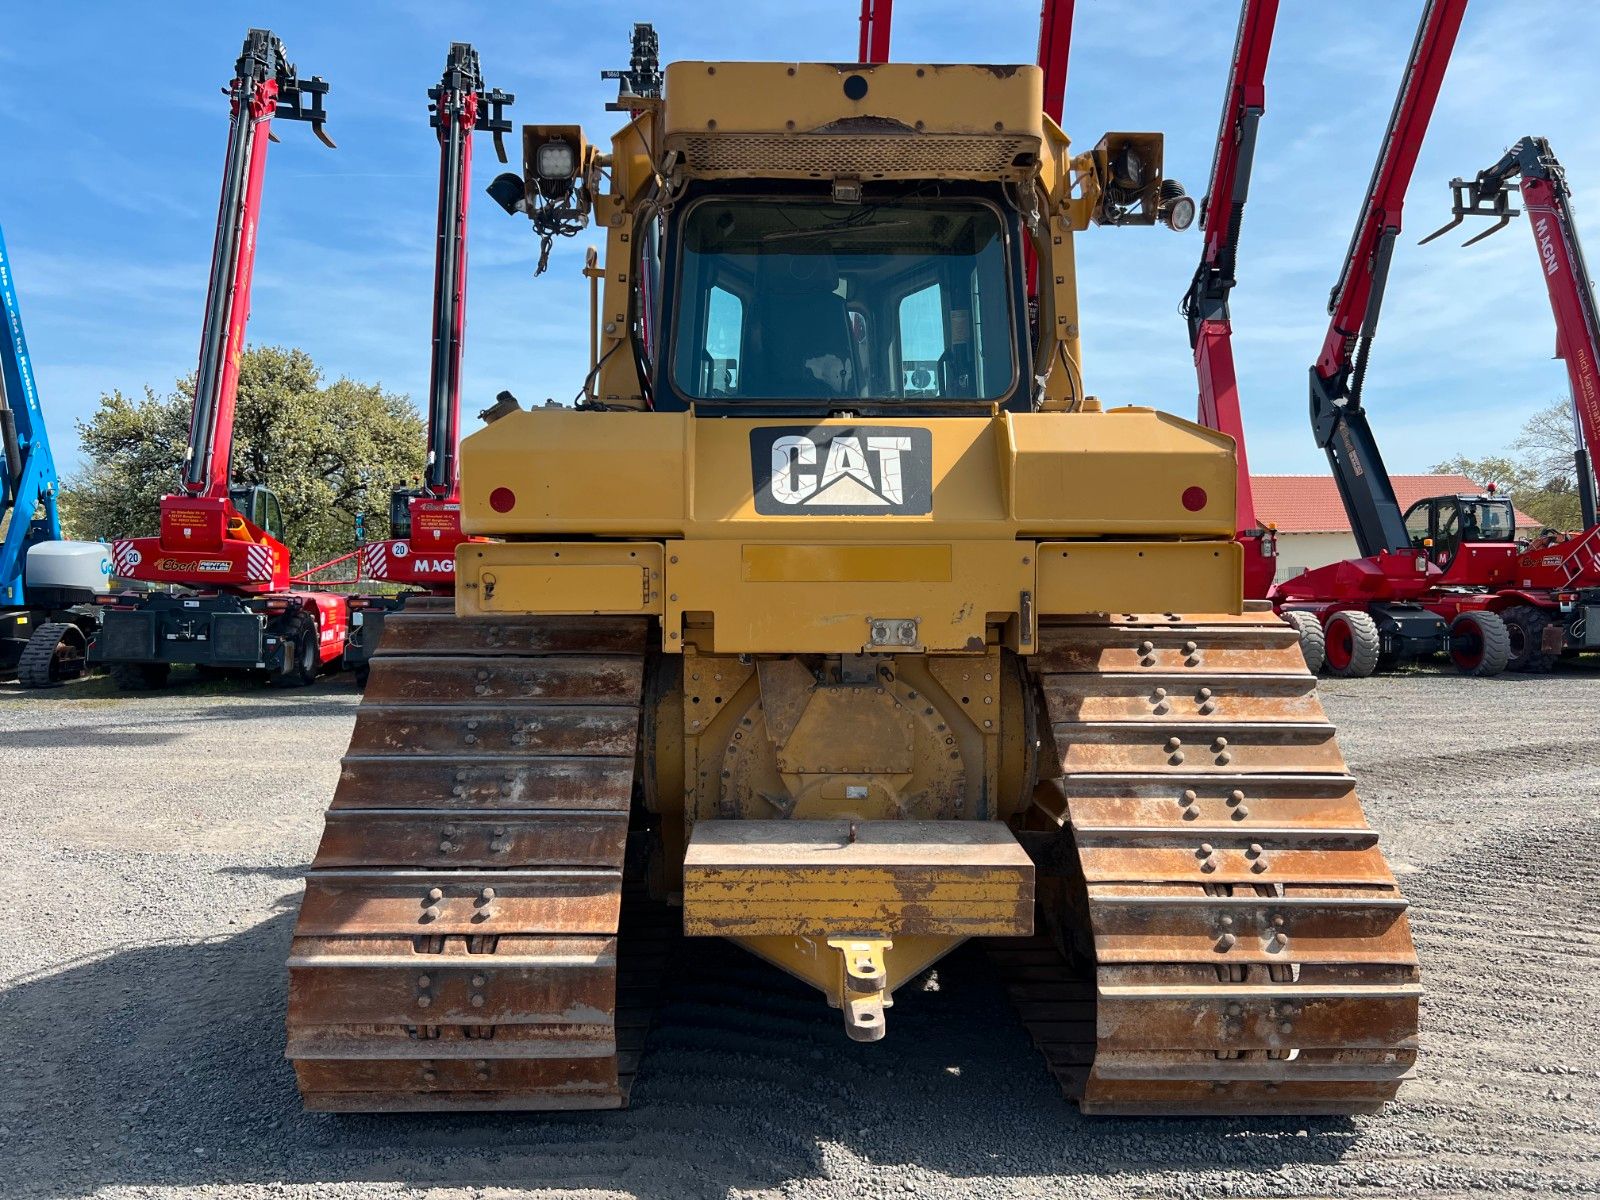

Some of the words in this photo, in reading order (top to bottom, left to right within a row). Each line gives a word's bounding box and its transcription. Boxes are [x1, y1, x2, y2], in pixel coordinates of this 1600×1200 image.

[1536, 217, 1559, 276] MAGNI
[1577, 348, 1589, 374] mich
[1583, 373, 1596, 399] kann
[771, 435, 912, 506] CAT
[395, 545, 405, 555] 20
[128, 553, 139, 563] 20
[162, 558, 197, 572] Ebert
[1438, 553, 1447, 564] M
[414, 559, 456, 573] MAG
